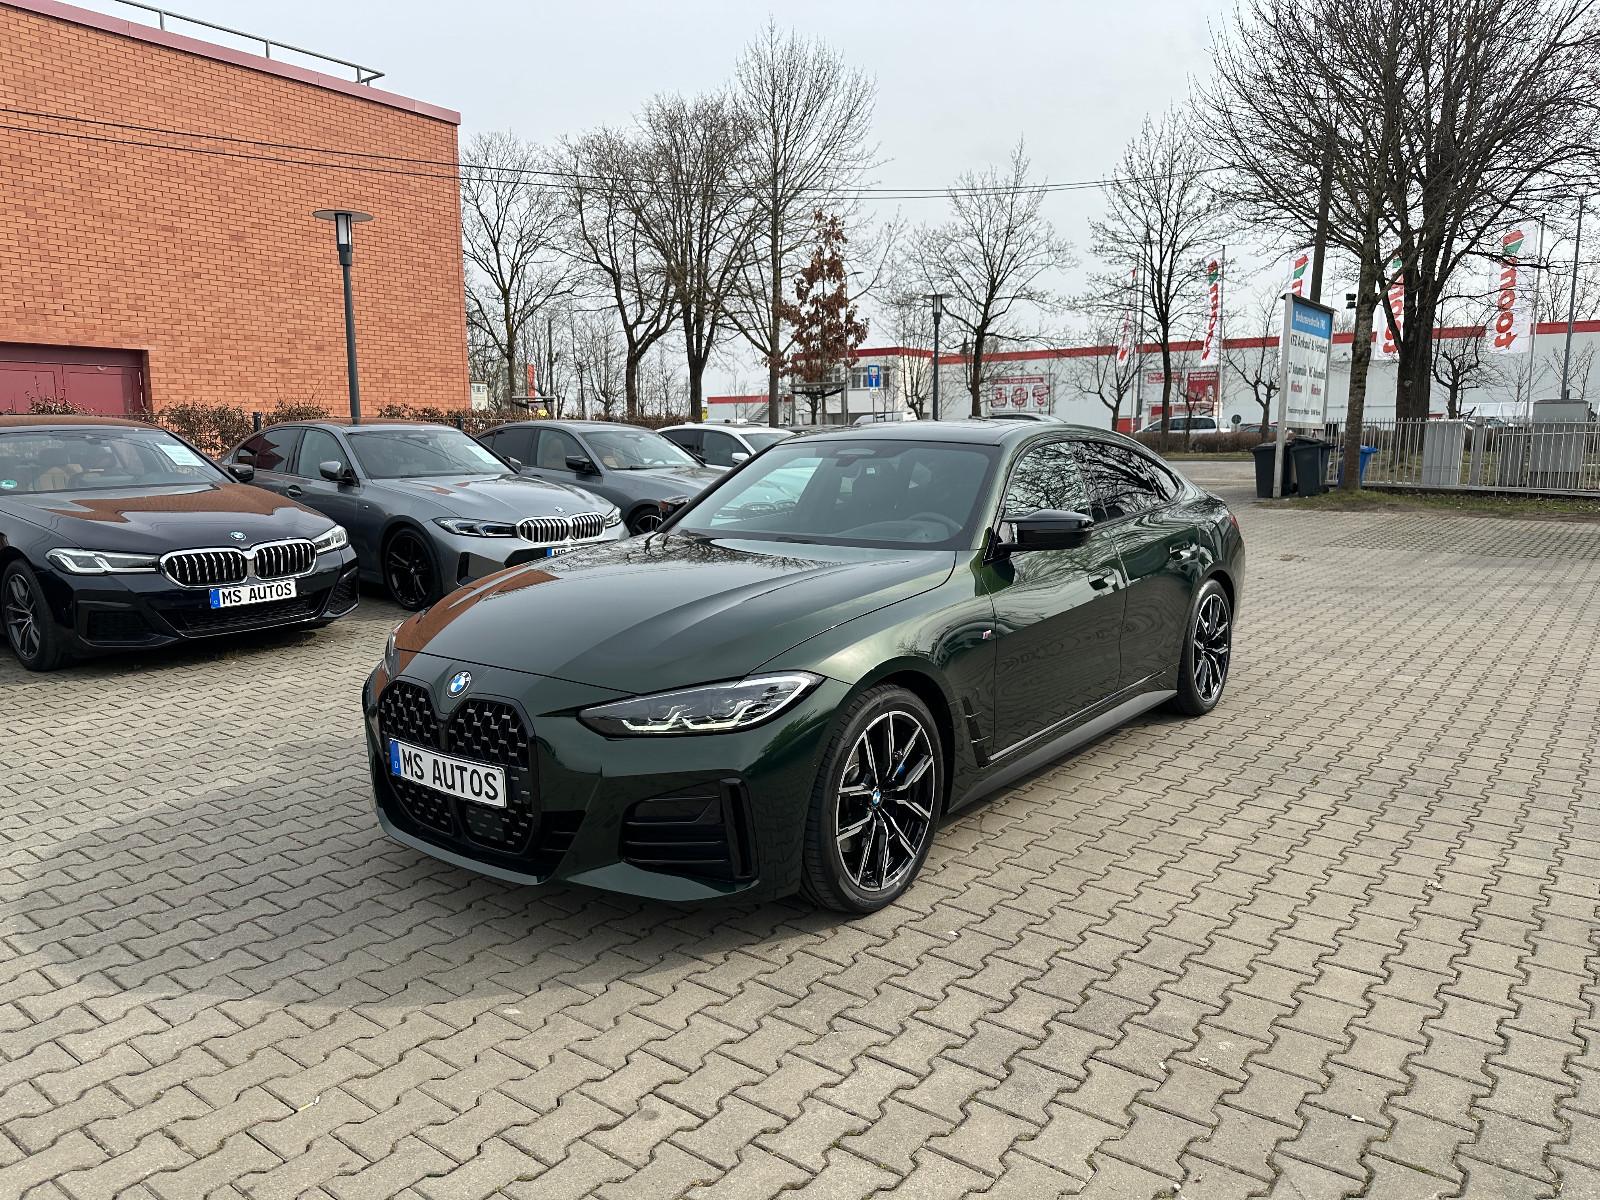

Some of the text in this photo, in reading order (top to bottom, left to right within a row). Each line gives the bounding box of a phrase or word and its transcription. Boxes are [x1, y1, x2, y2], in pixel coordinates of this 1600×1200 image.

[222, 582, 292, 605] MS AUTOS
[401, 748, 499, 801] MS AUTOS
